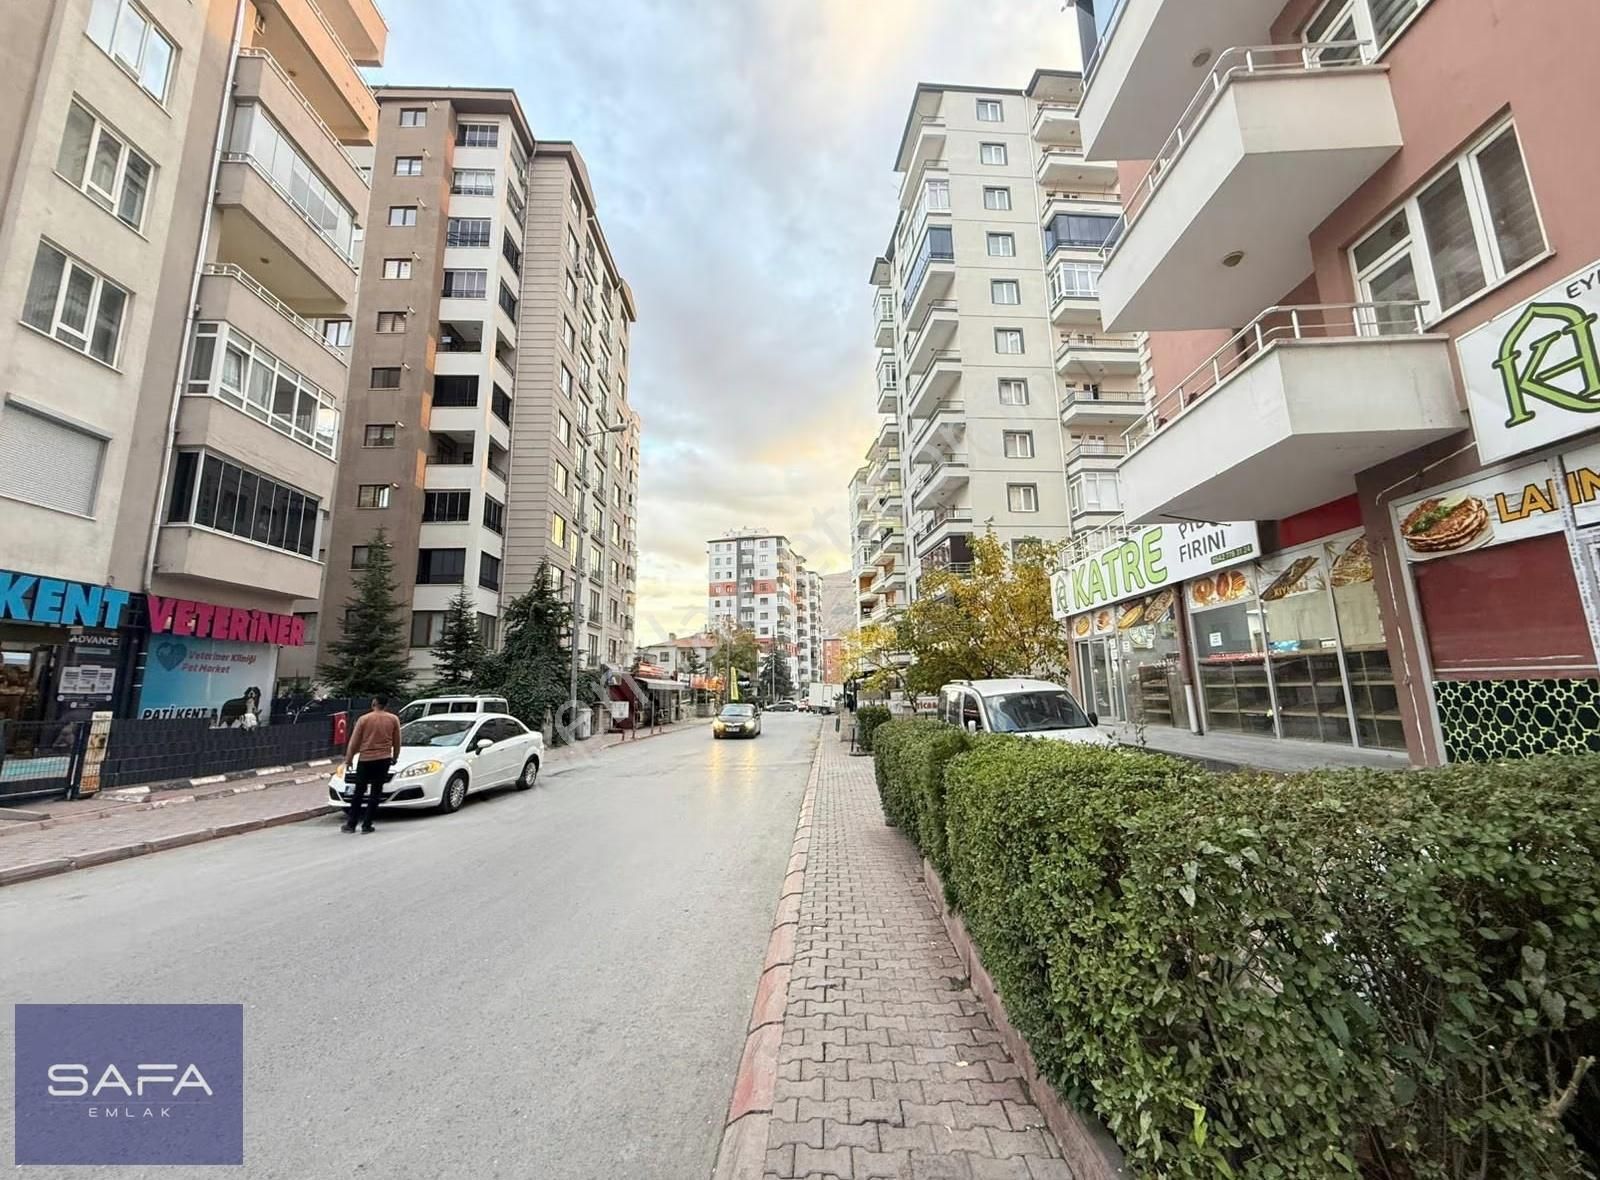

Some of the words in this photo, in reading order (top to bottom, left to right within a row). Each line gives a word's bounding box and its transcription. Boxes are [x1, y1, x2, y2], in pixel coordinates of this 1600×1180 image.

[1566, 269, 1600, 299] EY
[1179, 529, 1226, 563] FIRINI
[1072, 526, 1168, 610] KATRE
[0, 572, 129, 630] KENT
[69, 635, 120, 646] ADVANCE
